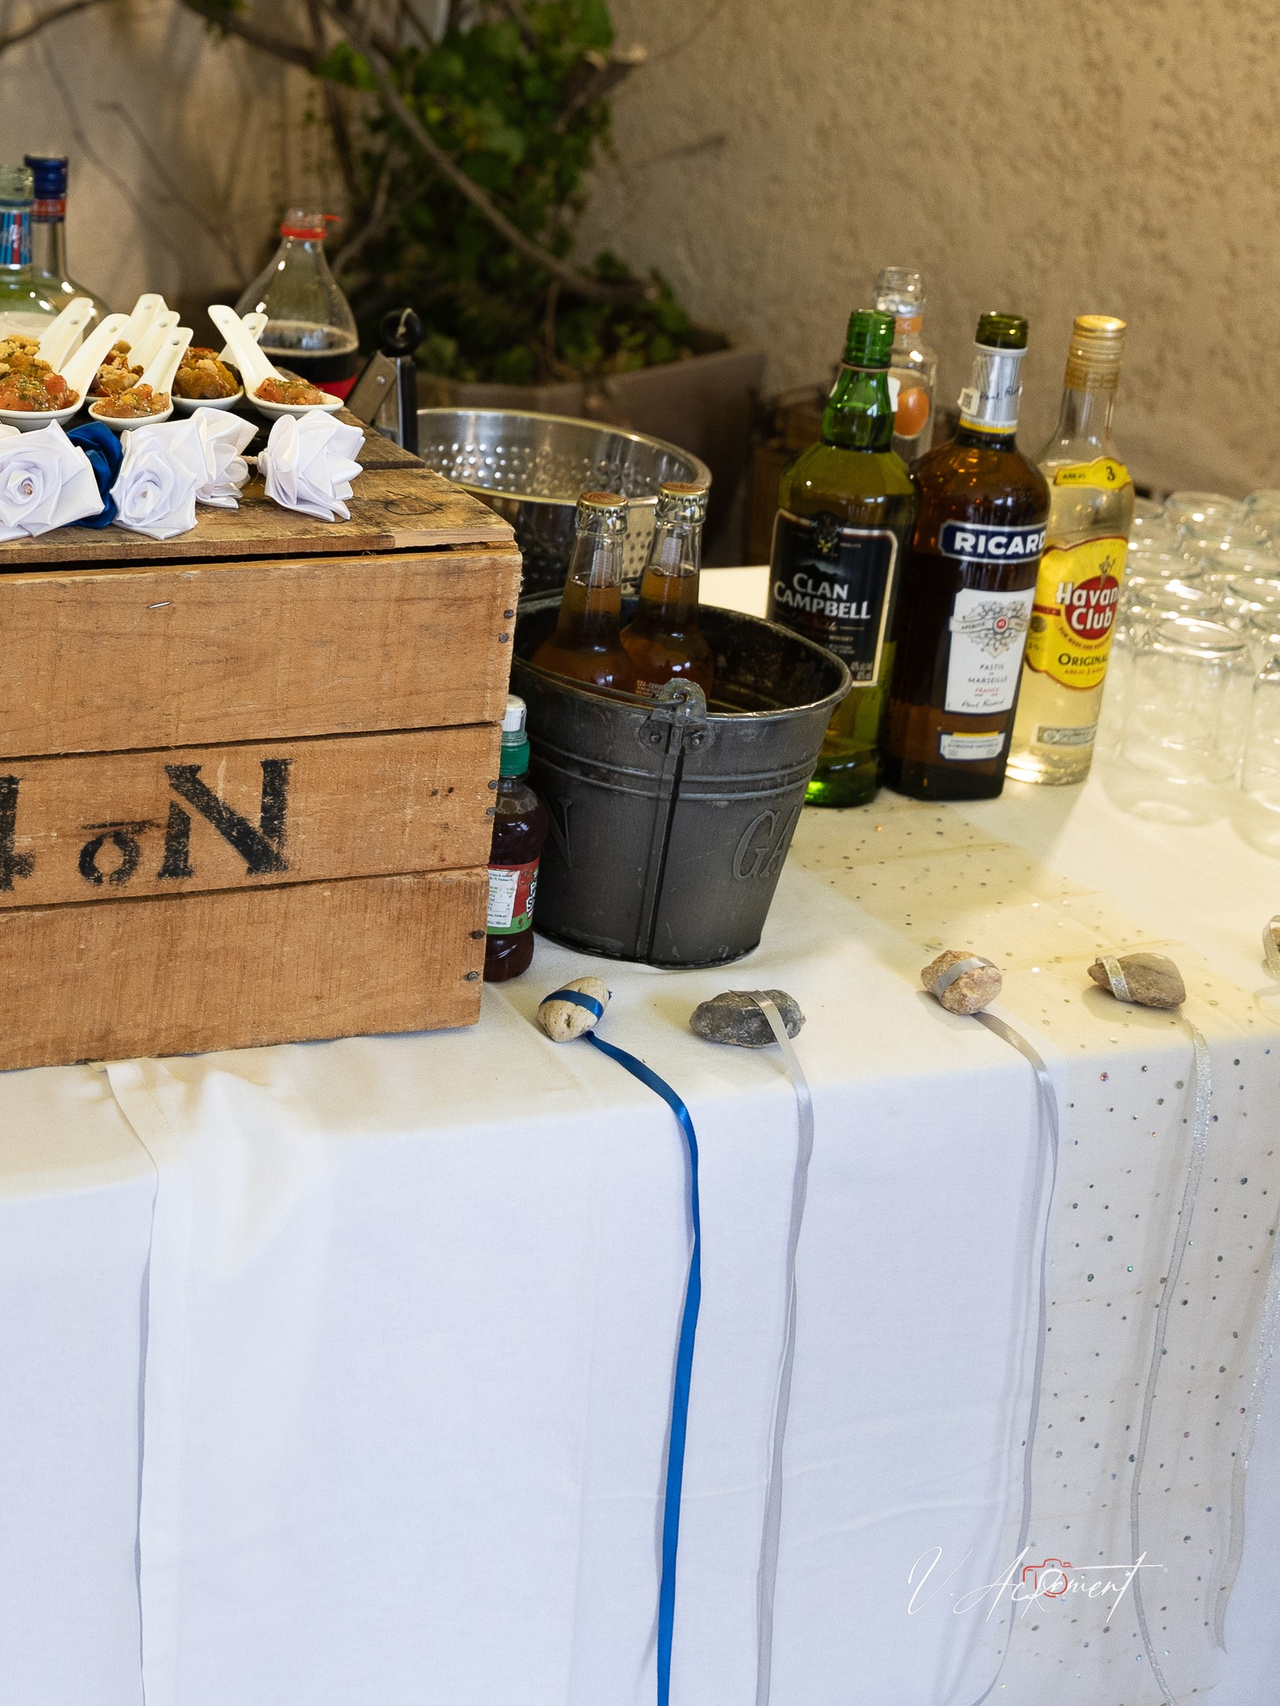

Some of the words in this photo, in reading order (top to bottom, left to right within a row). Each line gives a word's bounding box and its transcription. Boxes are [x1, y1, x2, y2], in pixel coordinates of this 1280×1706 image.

[1105, 466, 1116, 481] 3
[773, 581, 871, 619] CAMPBELL
[792, 573, 849, 601] CLAN
[1070, 607, 1114, 631] Club
